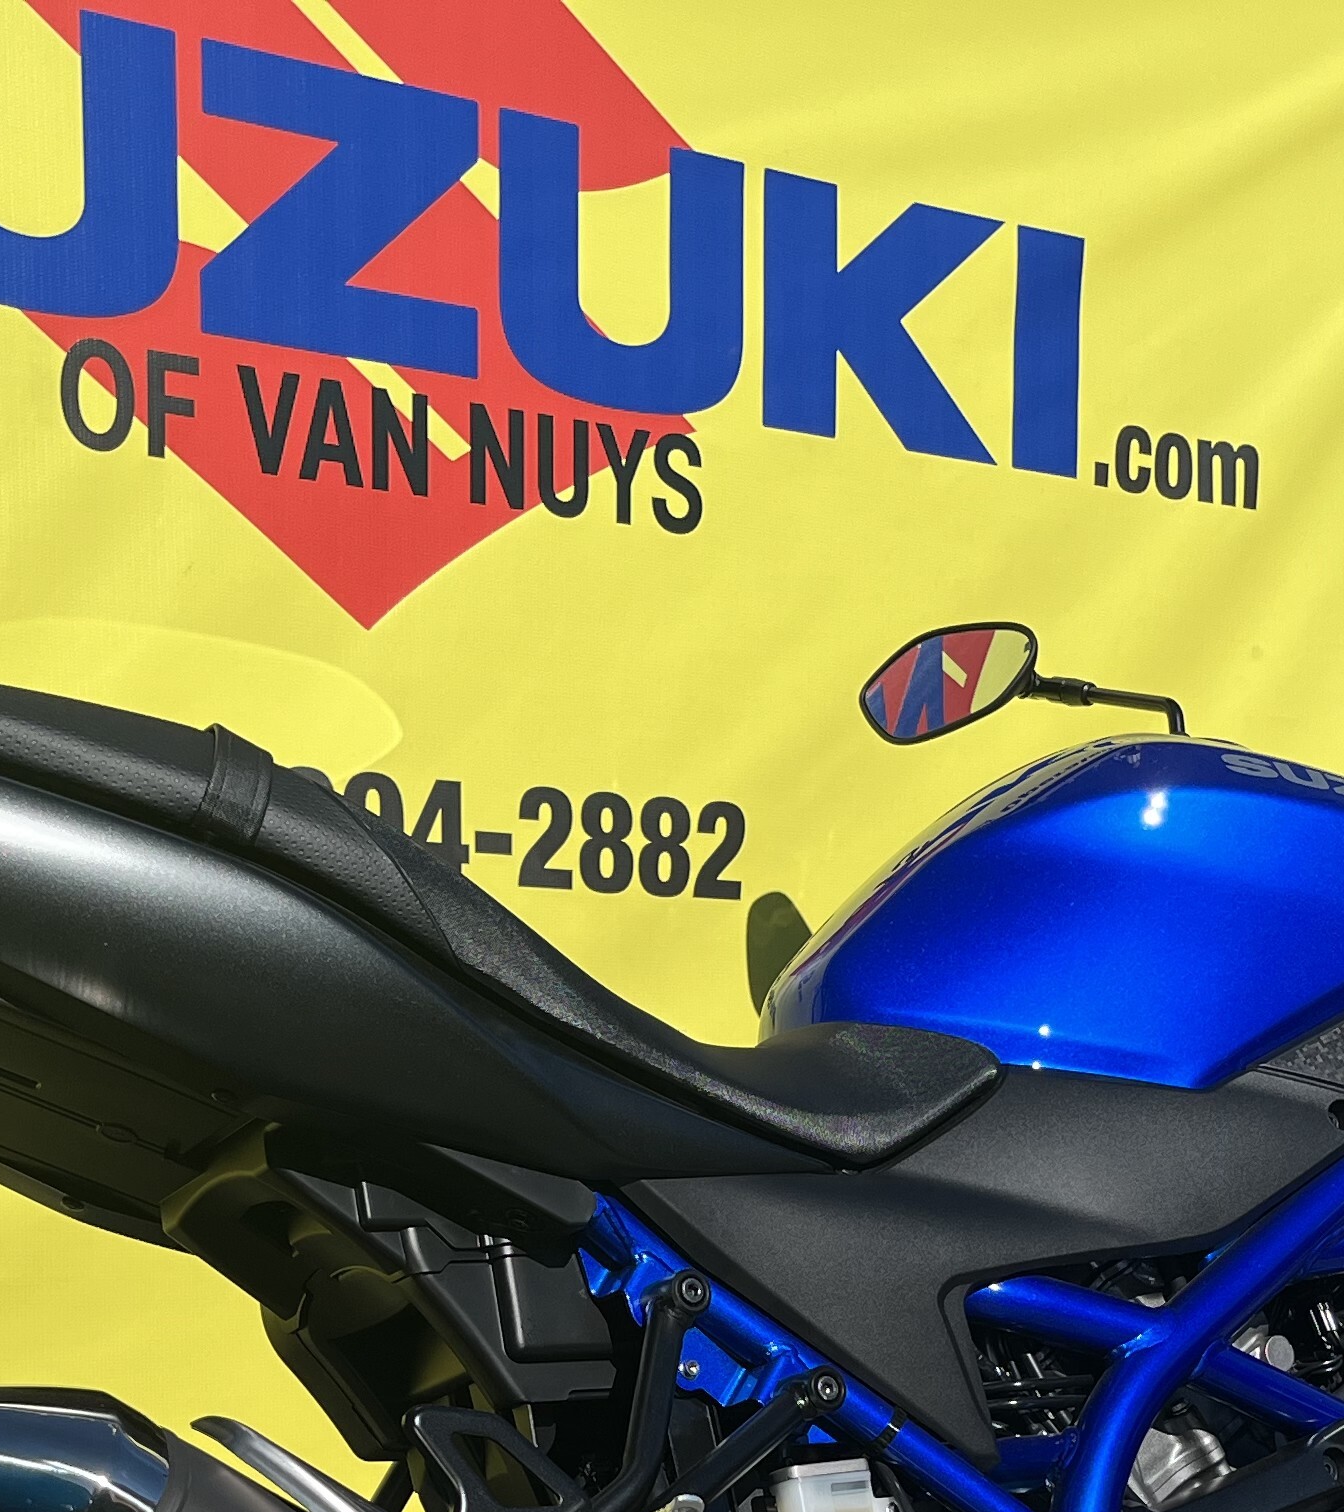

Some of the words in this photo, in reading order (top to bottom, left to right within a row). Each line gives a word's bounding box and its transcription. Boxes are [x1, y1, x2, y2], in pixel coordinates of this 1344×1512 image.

[60, 338, 199, 458] OF
[237, 364, 430, 498] VAN
[470, 402, 704, 535] NUYS
